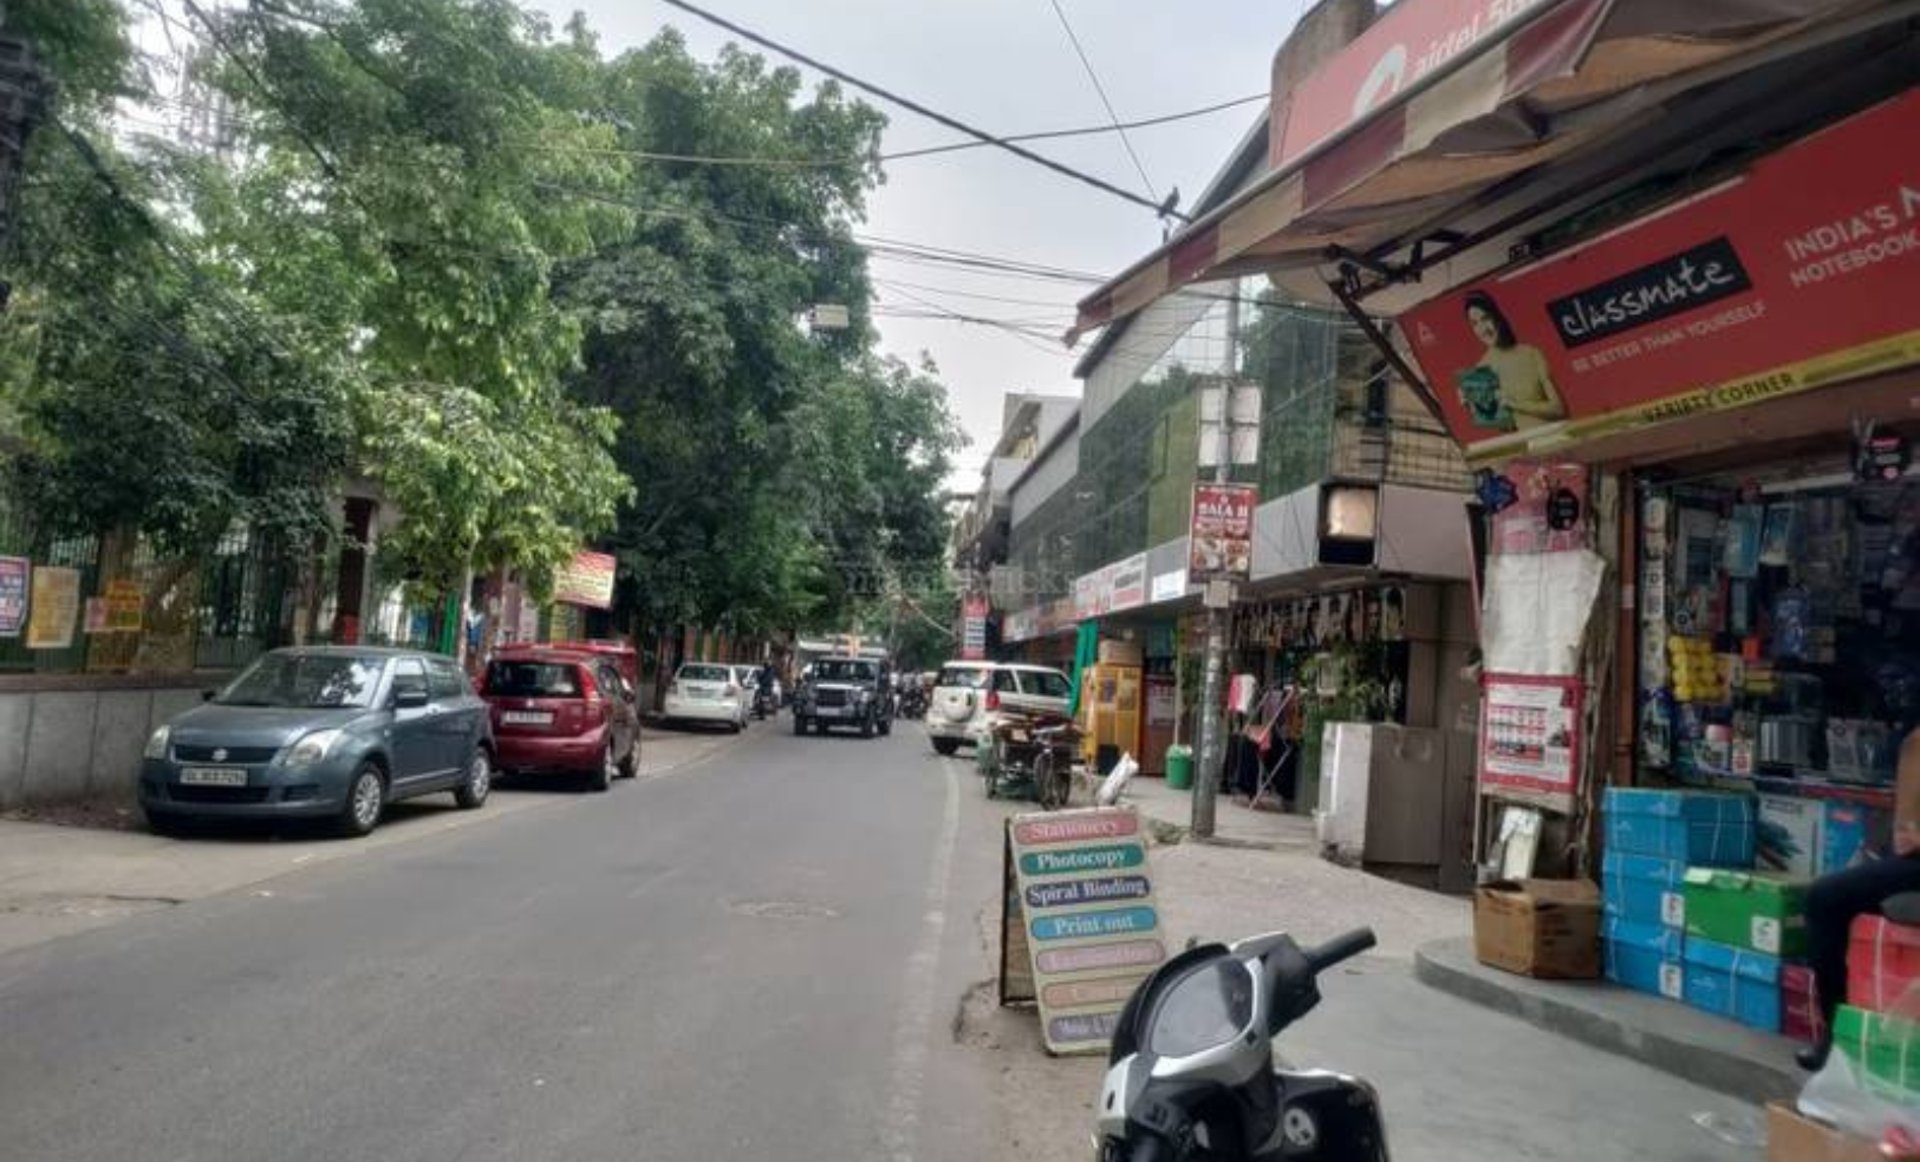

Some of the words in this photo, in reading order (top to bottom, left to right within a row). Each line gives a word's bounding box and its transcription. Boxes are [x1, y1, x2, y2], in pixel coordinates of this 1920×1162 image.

[1783, 205, 1899, 262] INDIA'S
[1789, 226, 1920, 288] NOTEBOOK
[1560, 256, 1735, 337] classmate
[1593, 339, 1643, 369] BETTER
[1687, 299, 1768, 341] YOURSELF
[1716, 371, 1794, 404] CORNER
[1037, 849, 1127, 871] Photocopy
[1030, 882, 1079, 908] Spiral
[1083, 875, 1148, 899] Binding
[1054, 914, 1099, 935] Print
